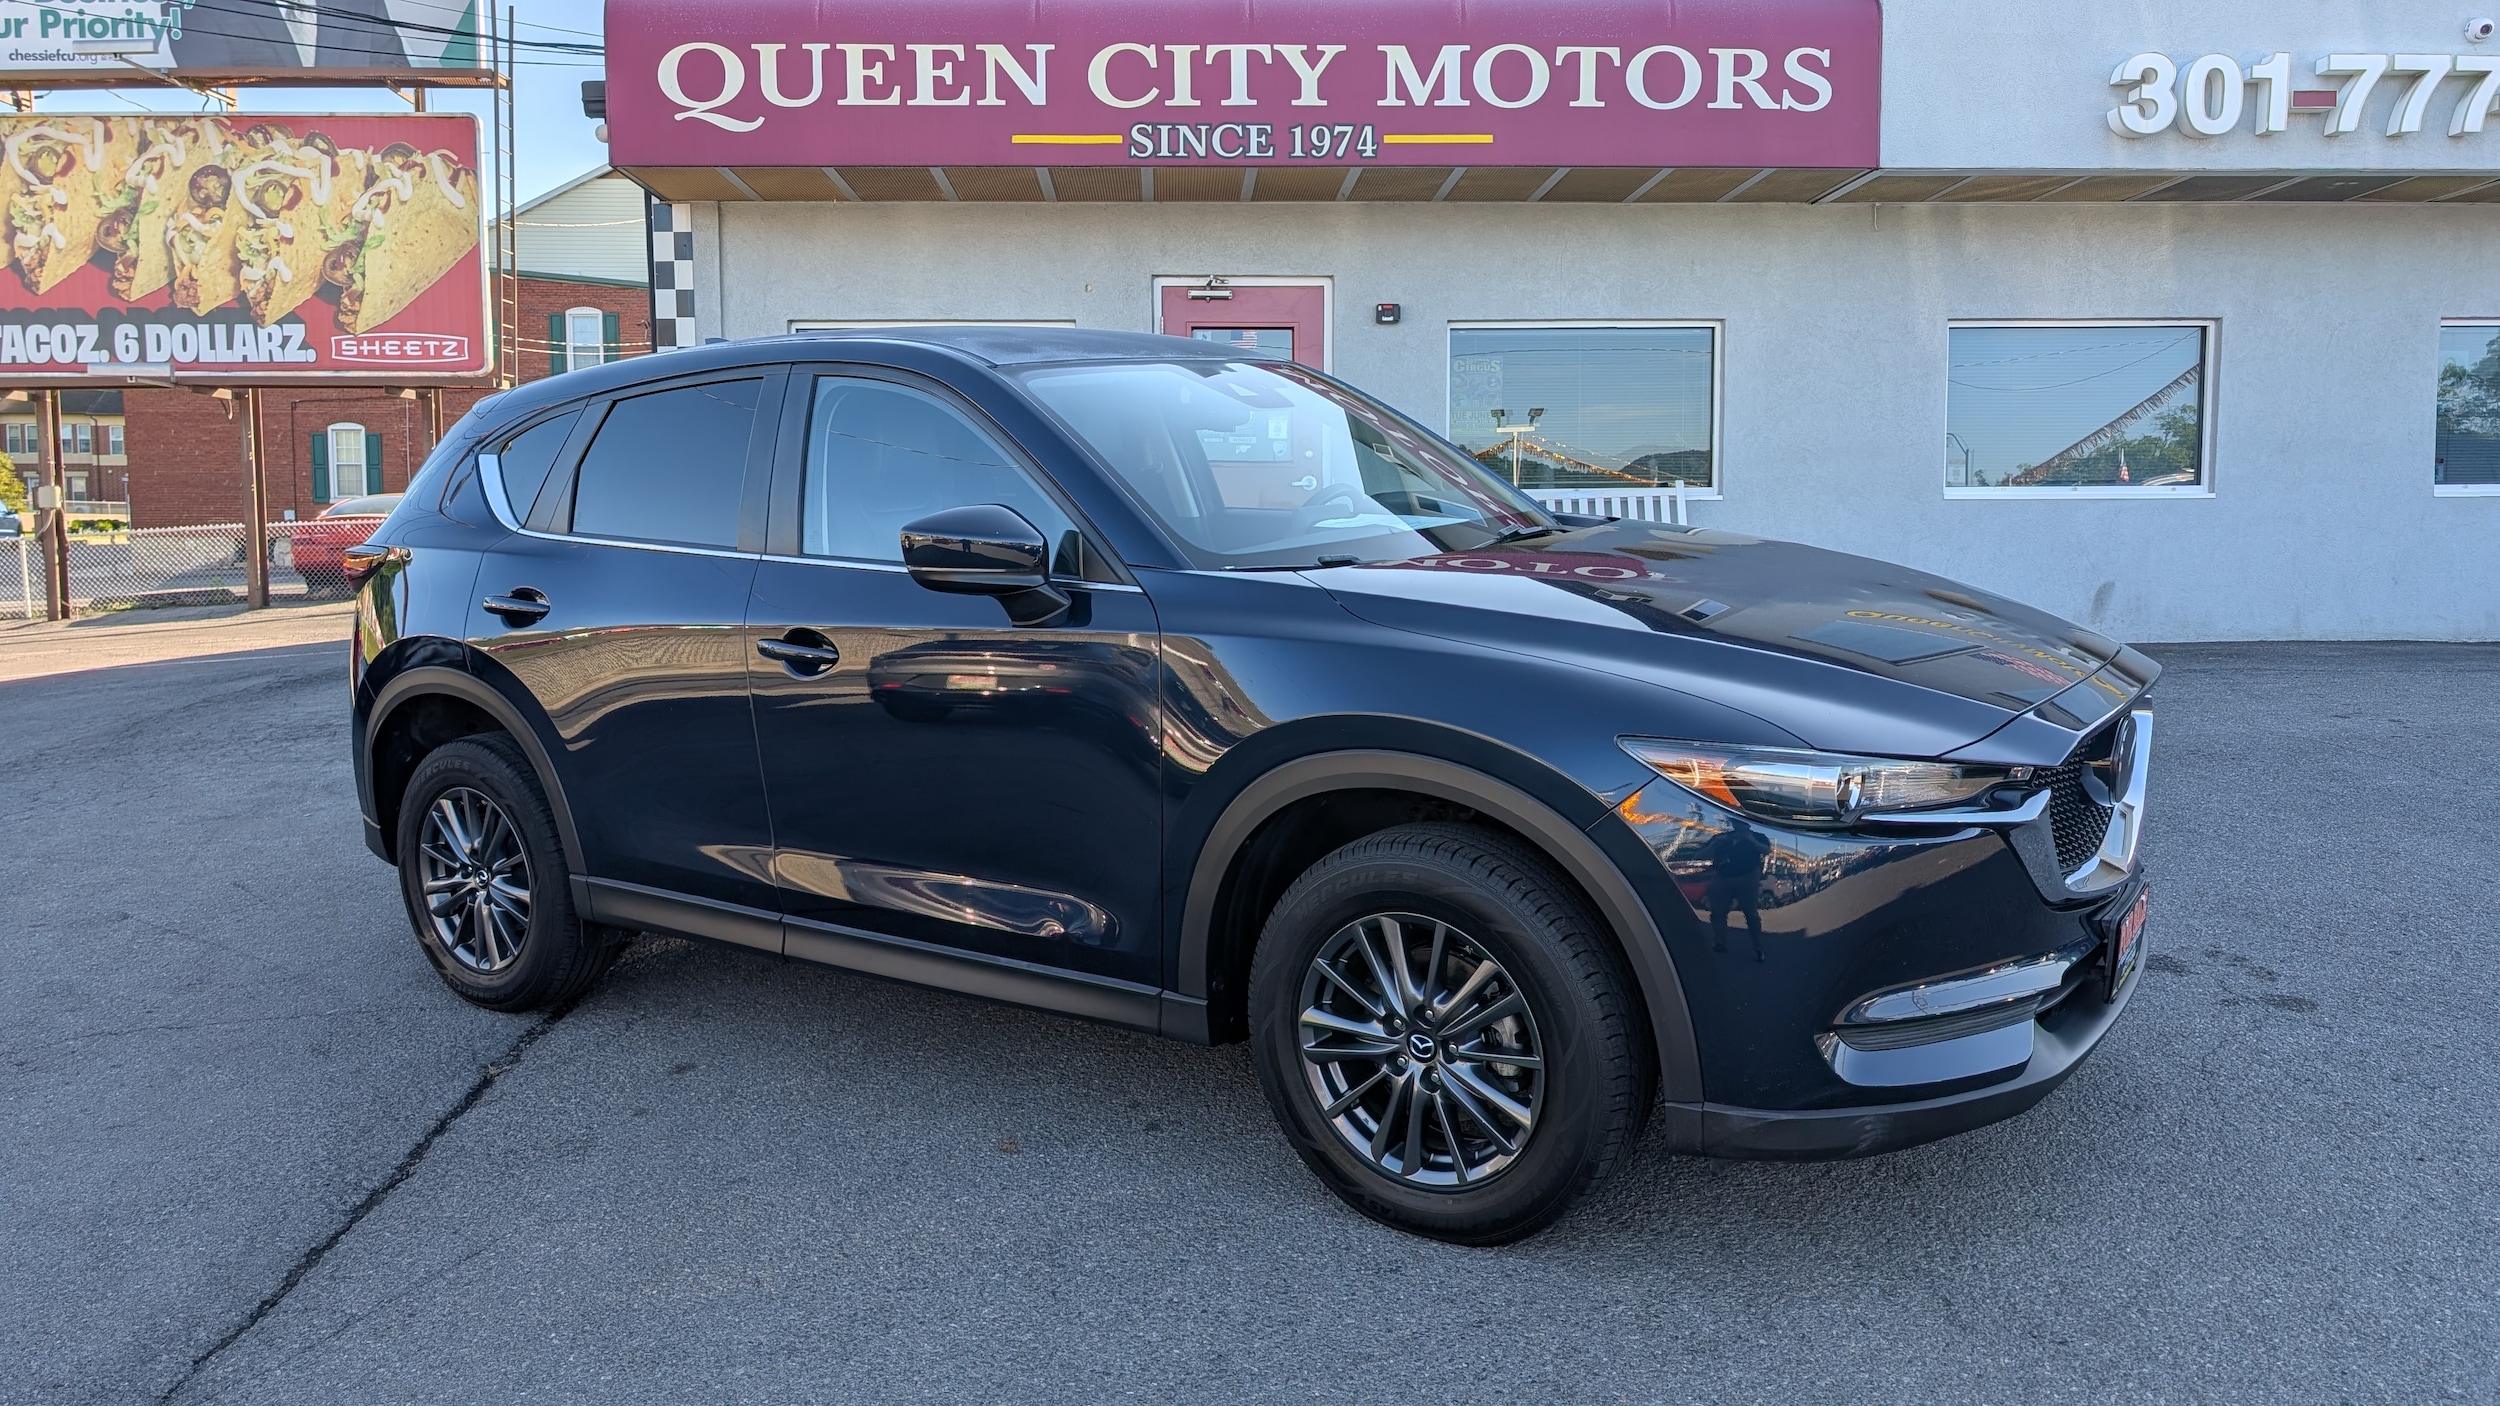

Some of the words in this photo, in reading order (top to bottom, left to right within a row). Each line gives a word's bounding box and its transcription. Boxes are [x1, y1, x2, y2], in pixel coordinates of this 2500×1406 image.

[40, 8, 182, 50] Priority!
[9, 48, 98, 65] chessiefcu.org
[657, 42, 1056, 133] QUEEN
[1087, 42, 1347, 109] CITY
[1376, 43, 1834, 112] MOTORS
[1130, 123, 1275, 158] SINCE
[1289, 124, 1379, 158] 1974
[0, 323, 110, 364] ACOZ.
[114, 323, 141, 364] 6
[144, 322, 318, 364] DOLLARZ.
[341, 340, 460, 357] SHEETZ
